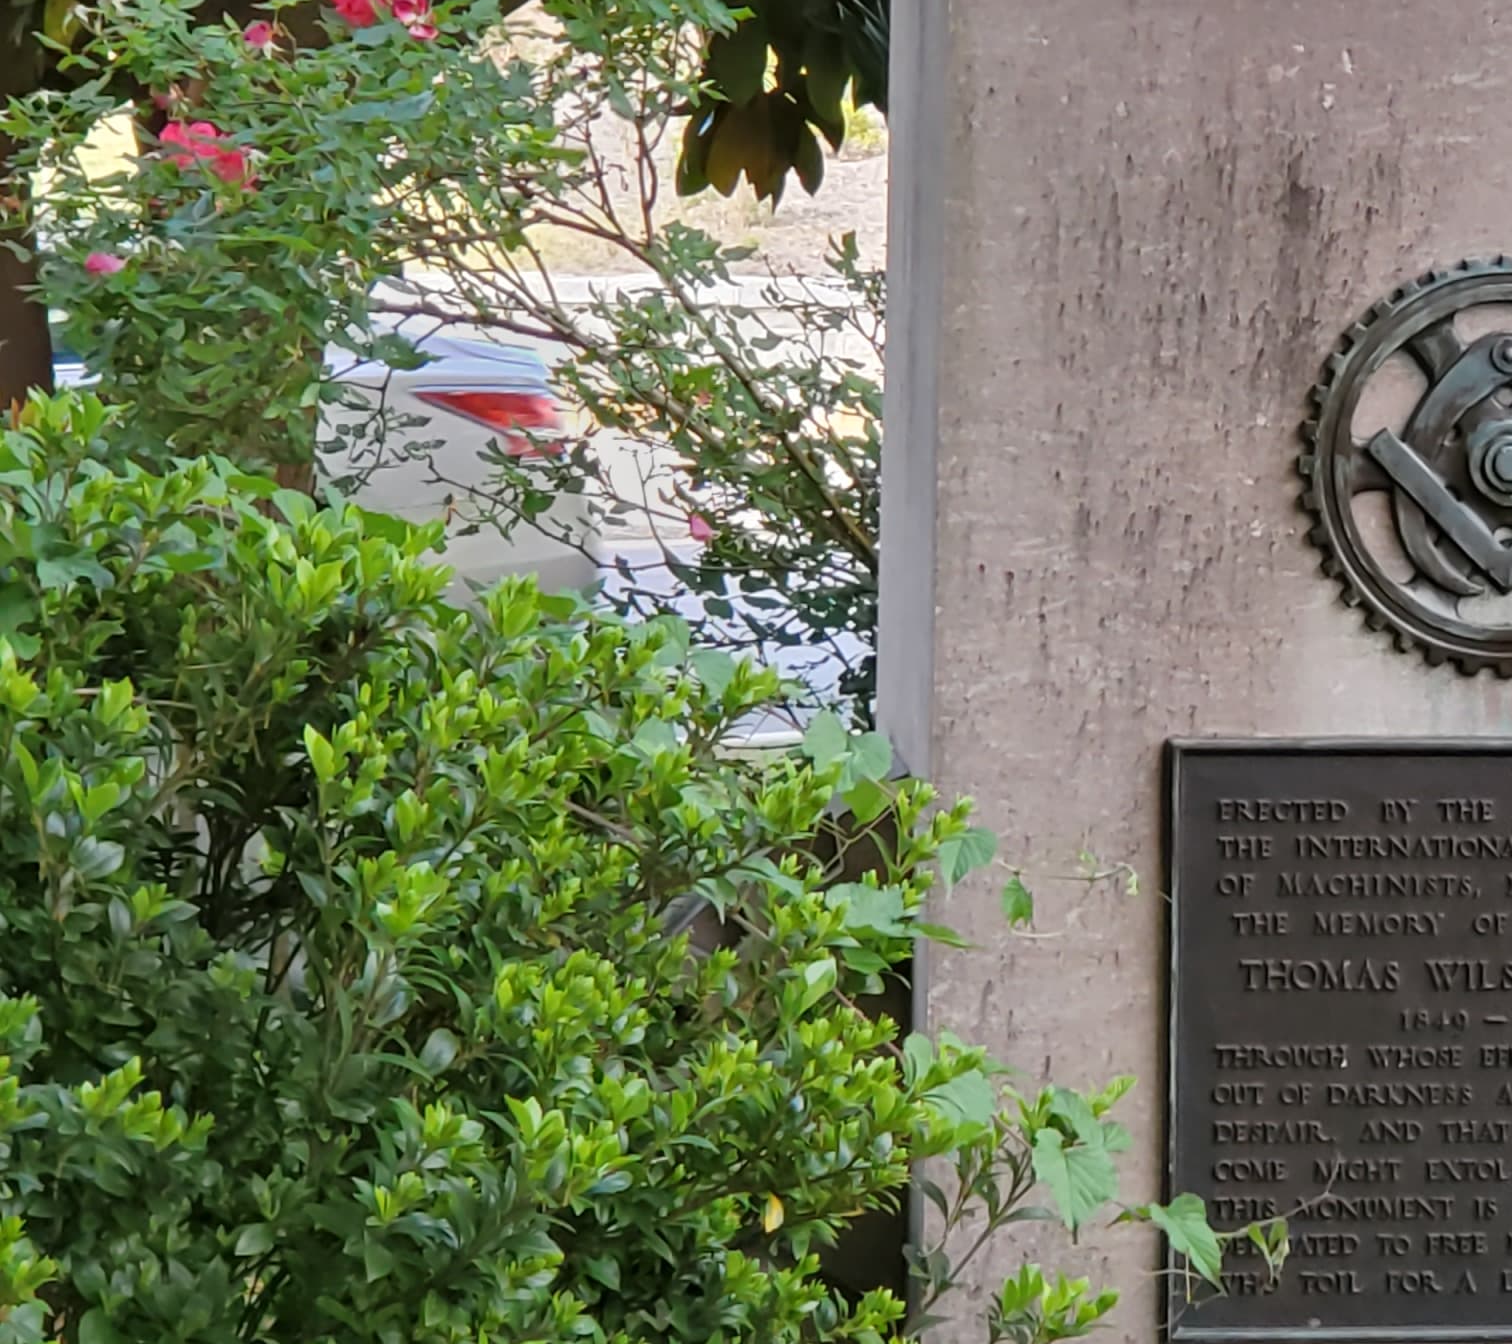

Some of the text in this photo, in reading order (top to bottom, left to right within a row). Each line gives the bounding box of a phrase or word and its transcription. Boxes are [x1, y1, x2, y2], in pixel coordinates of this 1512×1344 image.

[1216, 799, 1349, 824] ERECTED
[1381, 799, 1418, 824] BY
[1437, 799, 1495, 824] THE
[1216, 836, 1272, 860] THE
[1216, 873, 1252, 898] OF
[1277, 873, 1480, 898] MACHINISTS,
[1232, 912, 1289, 937] THE
[1313, 912, 1445, 937] MEMORY
[1472, 912, 1507, 937] OF
[1238, 959, 1400, 992] THOMAS
[1214, 1046, 1348, 1070] THROUGH
[1368, 1046, 1463, 1070] WHOSE
[1211, 1083, 1263, 1106] OUT
[1281, 1083, 1311, 1106] OF
[1328, 1083, 1472, 1106] DARKNESS
[1359, 1121, 1421, 1145] AND
[1439, 1121, 1511, 1145] THAT
[1212, 1159, 1288, 1183] COME
[1313, 1159, 1401, 1183] MIGHT
[1425, 1159, 1508, 1183] EXTOL
[1212, 1196, 1276, 1220] THIS
[1296, 1196, 1453, 1220] MONUMENT
[1473, 1196, 1497, 1220] IS
[1375, 1231, 1411, 1256] TO
[1425, 1231, 1487, 1256] FREE
[1301, 1269, 1362, 1296] TOIL
[1385, 1269, 1443, 1296] FOR
[1453, 1269, 1478, 1296] A
